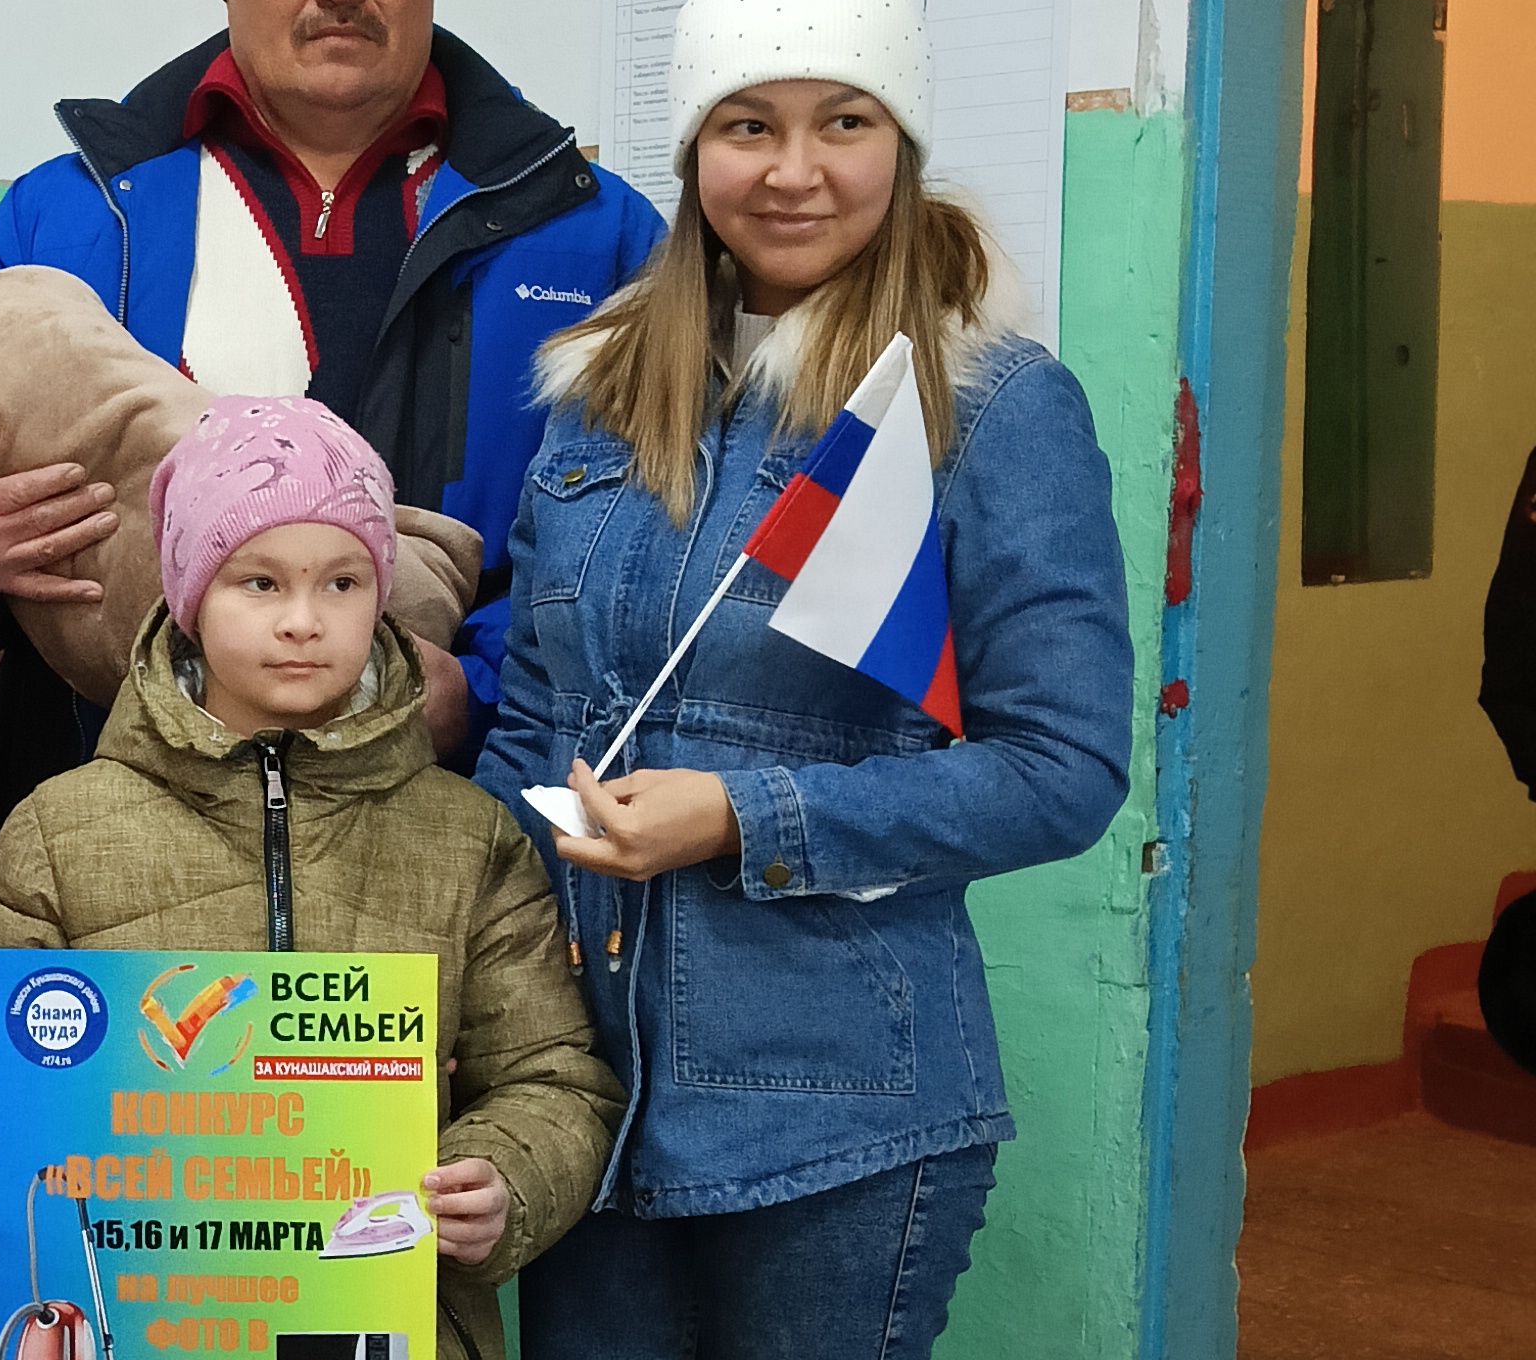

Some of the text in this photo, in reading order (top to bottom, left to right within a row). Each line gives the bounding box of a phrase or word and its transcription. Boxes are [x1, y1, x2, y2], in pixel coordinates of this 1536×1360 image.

[530, 285, 592, 305] Columbia
[272, 965, 369, 1002] ВСЕЙ
[31, 1003, 82, 1020] Знамя
[270, 1006, 423, 1042] СЕМЬЕЙ
[30, 1025, 78, 1042] труда
[255, 1062, 273, 1075] ЗА
[275, 1060, 371, 1076] КУНАШАКСКИЙ
[111, 1091, 305, 1136] КОНКУРС
[45, 1148, 371, 1201] «ВСЕЙ СЕМЬЕЙ»
[92, 1220, 324, 1252] 15,16 и 17 МАРТА
[117, 1273, 299, 1306] на лучшее
